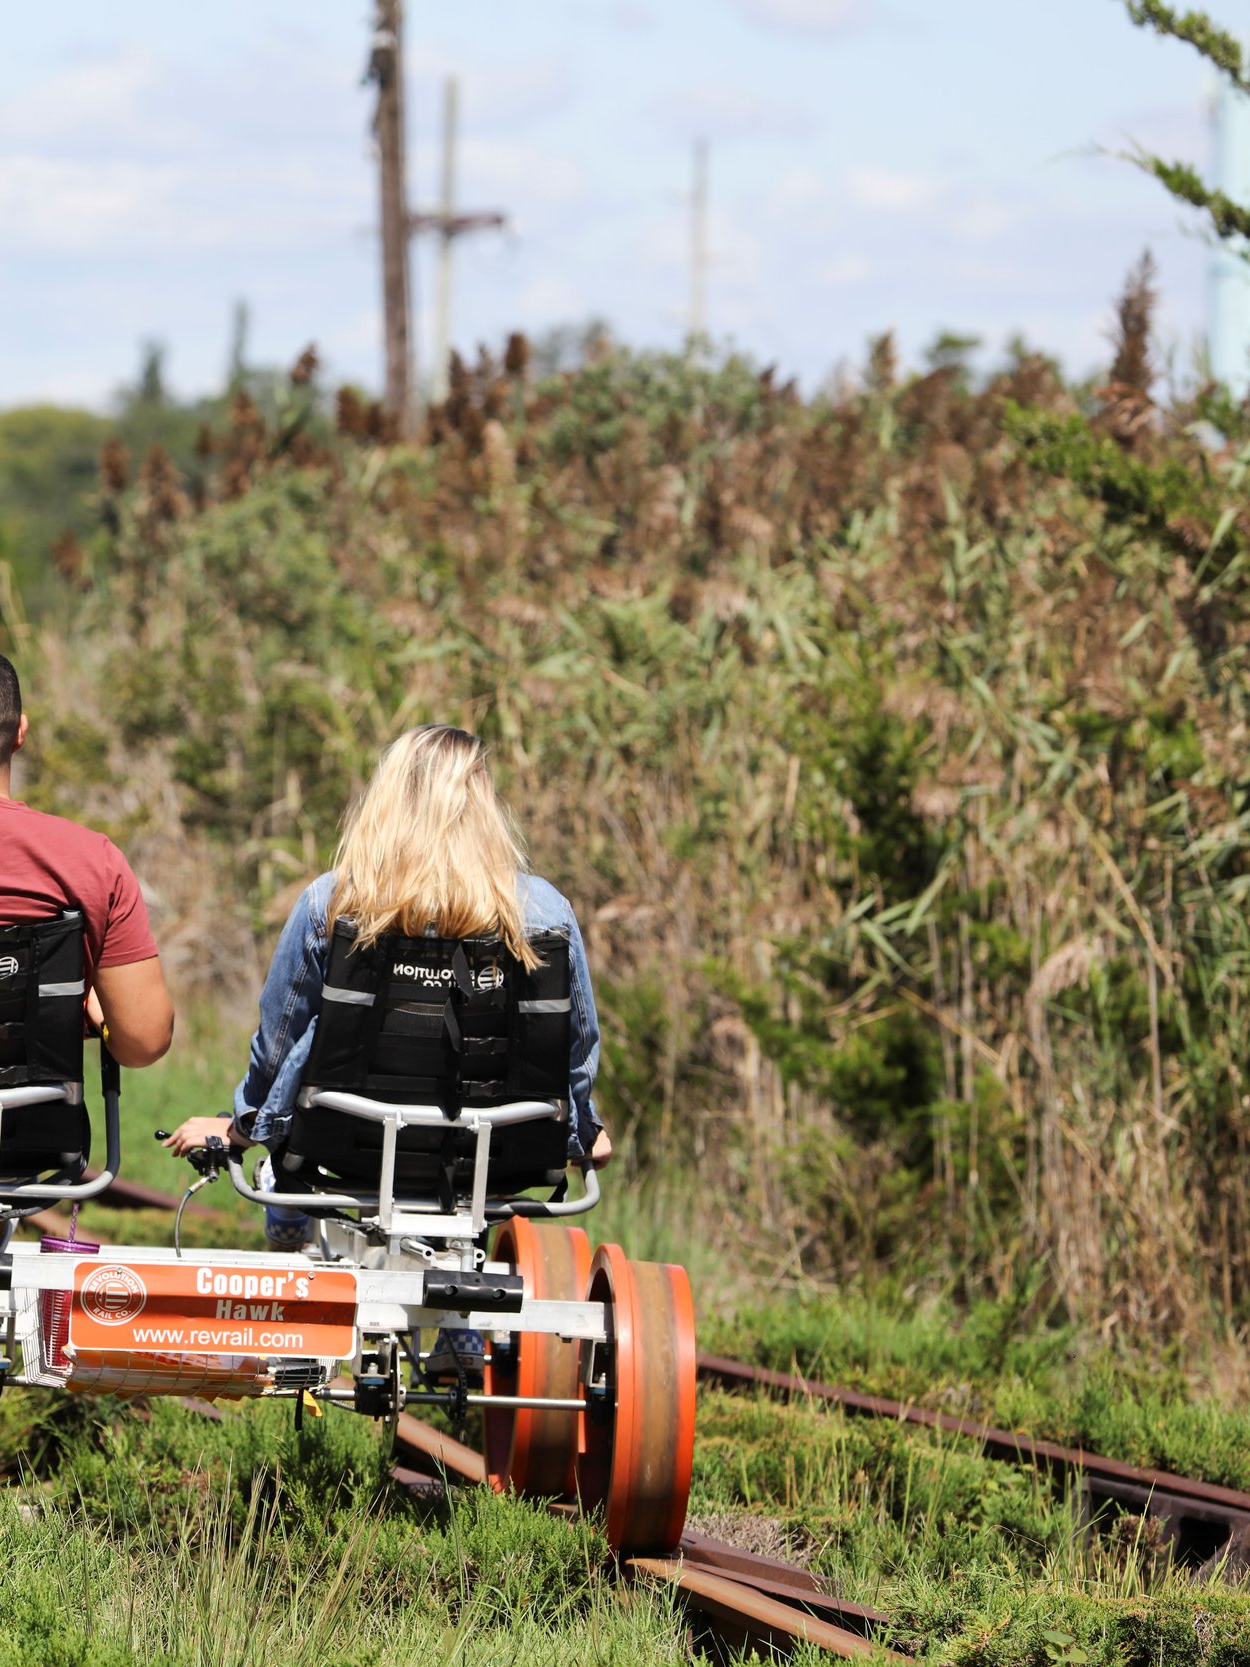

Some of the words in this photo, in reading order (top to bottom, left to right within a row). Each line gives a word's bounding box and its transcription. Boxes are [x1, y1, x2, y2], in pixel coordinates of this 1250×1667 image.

[88, 1271, 140, 1294] REVOLUTION
[196, 1267, 310, 1299] Cooper's
[93, 1307, 113, 1320] RAIL
[215, 1299, 285, 1322] Hawk
[132, 1327, 304, 1348] www.revrail.com
